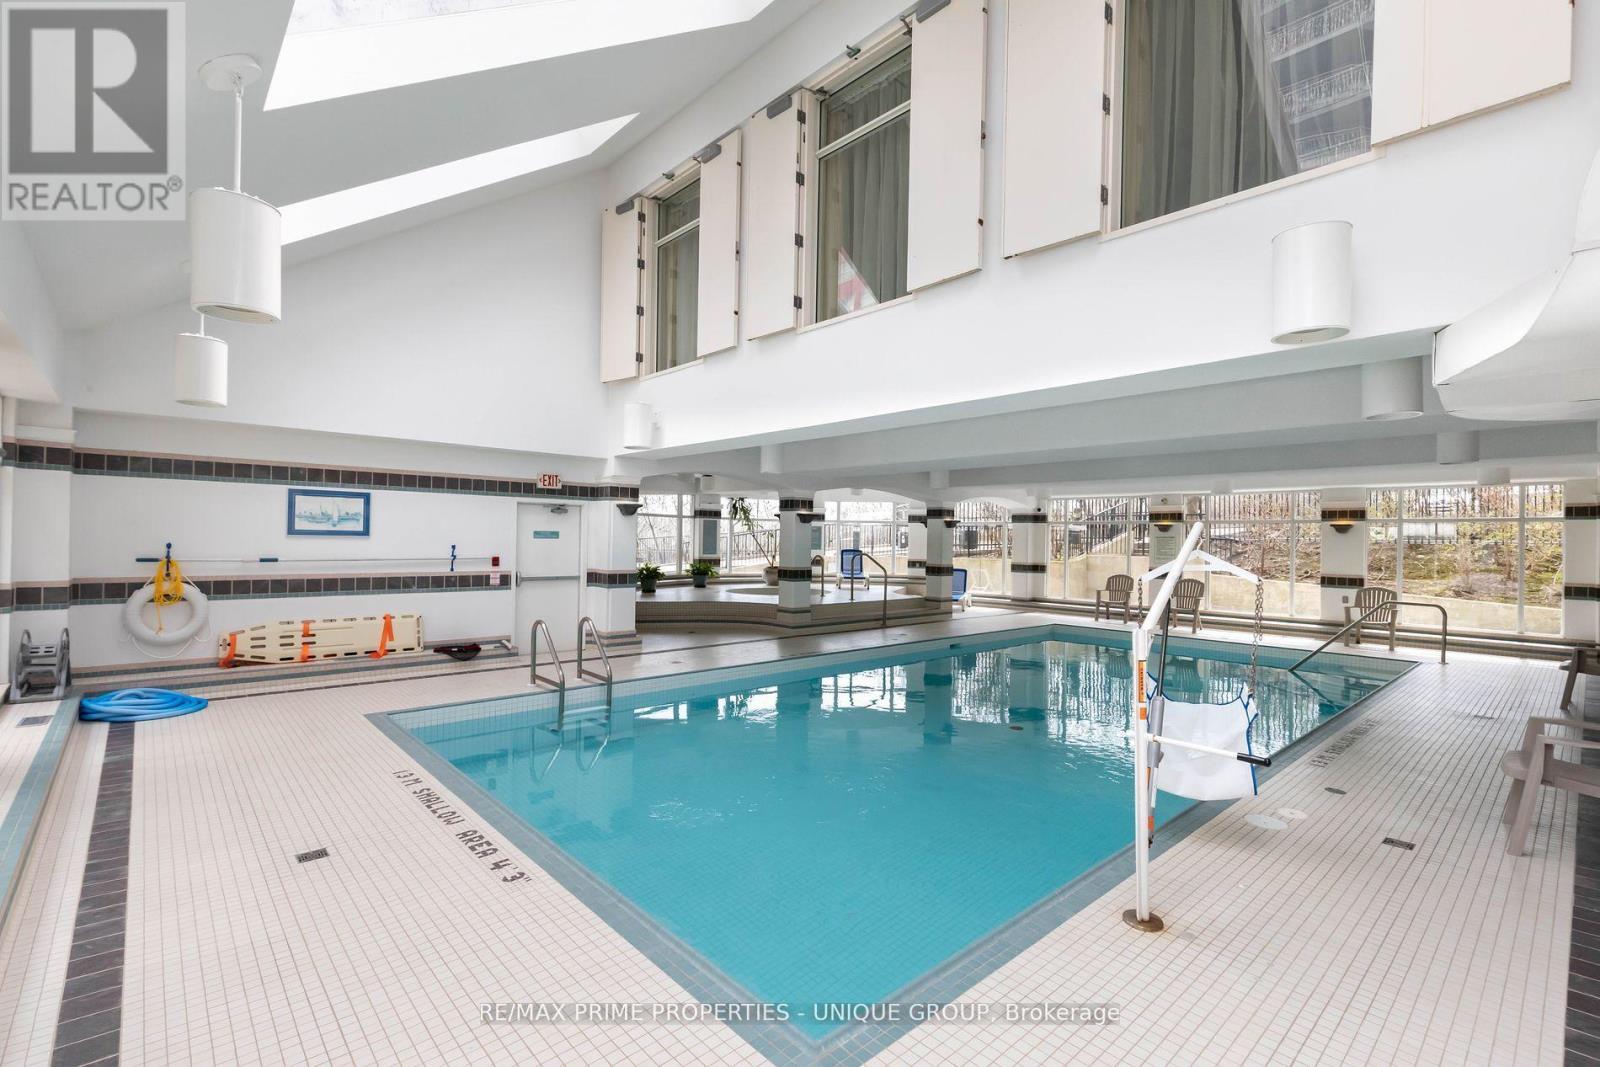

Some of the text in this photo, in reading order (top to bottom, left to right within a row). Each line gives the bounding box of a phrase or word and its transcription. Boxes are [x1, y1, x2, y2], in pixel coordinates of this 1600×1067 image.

[542, 474, 559, 487] EXIT
[412, 787, 466, 826] SHALLOW
[455, 829, 499, 859] AREA
